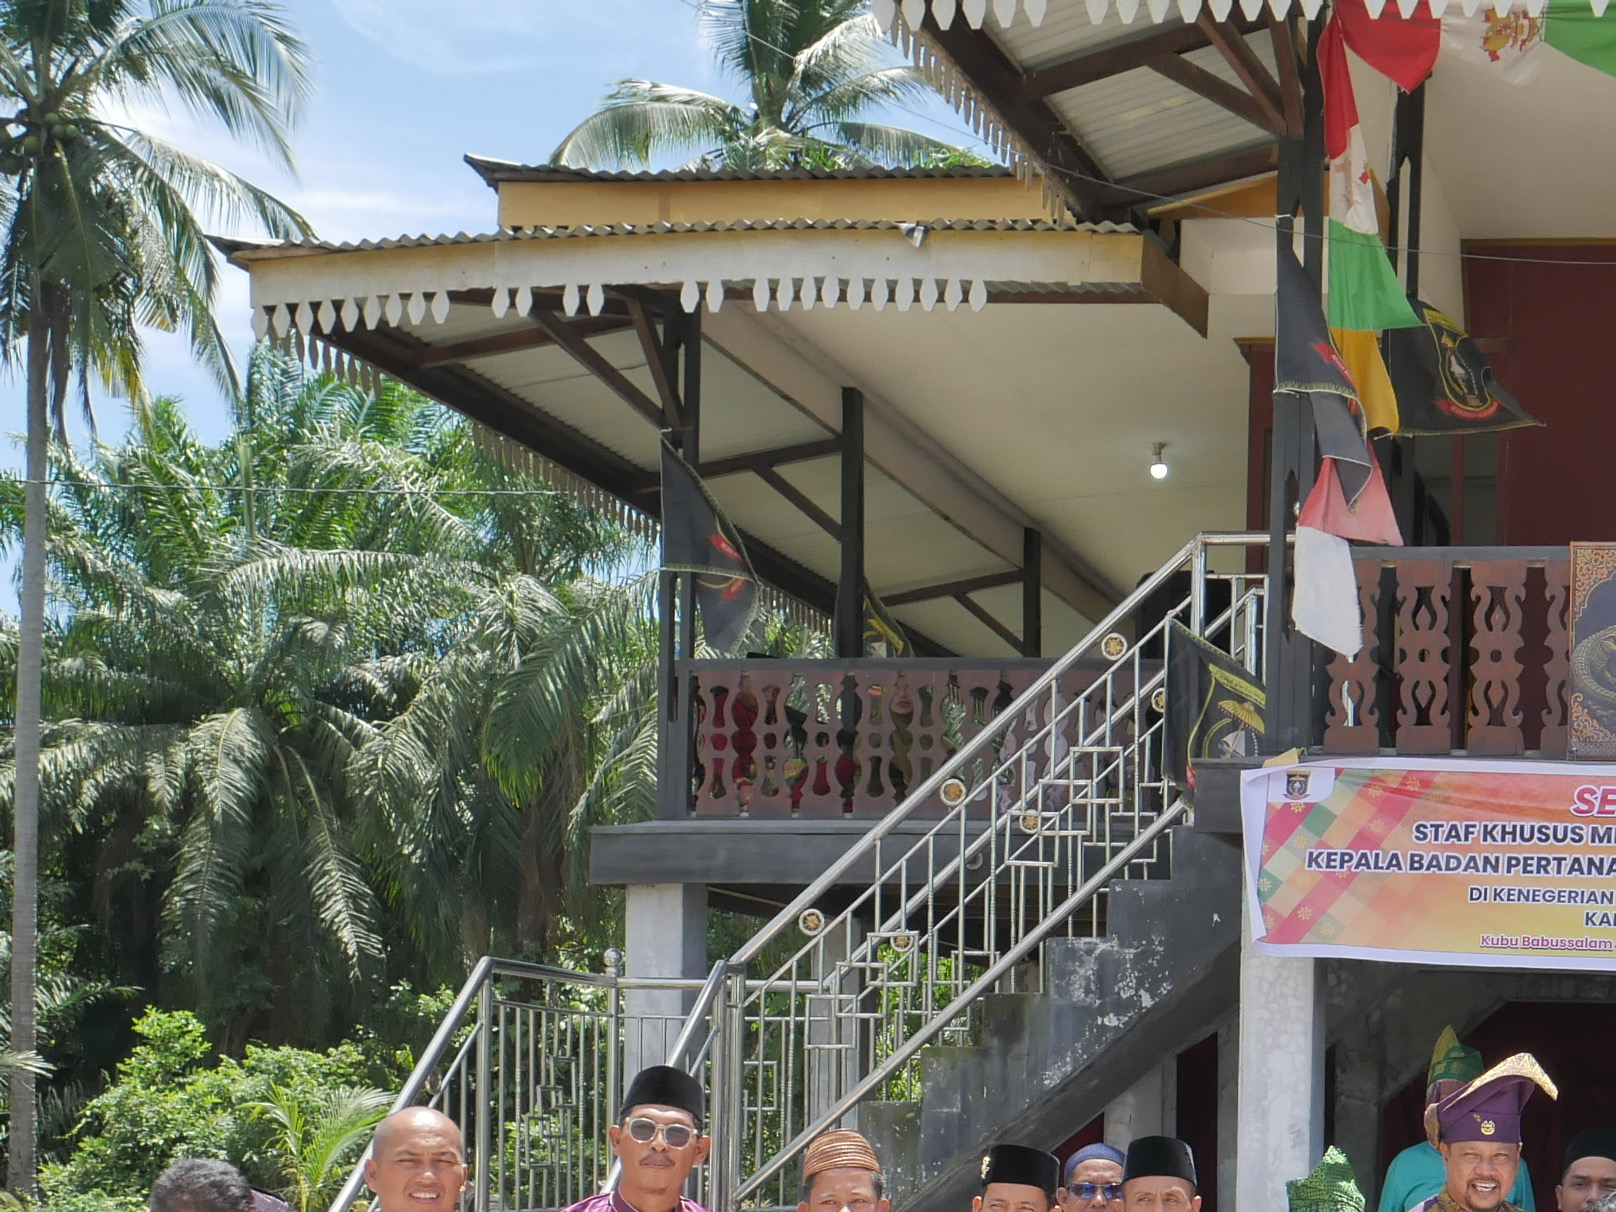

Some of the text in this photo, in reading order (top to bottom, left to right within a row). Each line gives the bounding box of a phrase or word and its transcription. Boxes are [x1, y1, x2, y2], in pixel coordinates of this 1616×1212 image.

[1414, 823, 1477, 842] STAF
[1483, 823, 1583, 843] KHUSUS
[1306, 851, 1403, 871] KEPALA
[1409, 853, 1500, 873] BADAN
[1469, 887, 1488, 902] DI
[1494, 889, 1614, 905] KENEGERIAN
[1481, 935, 1518, 947] Kubu
[1522, 936, 1613, 950] Babussalam
